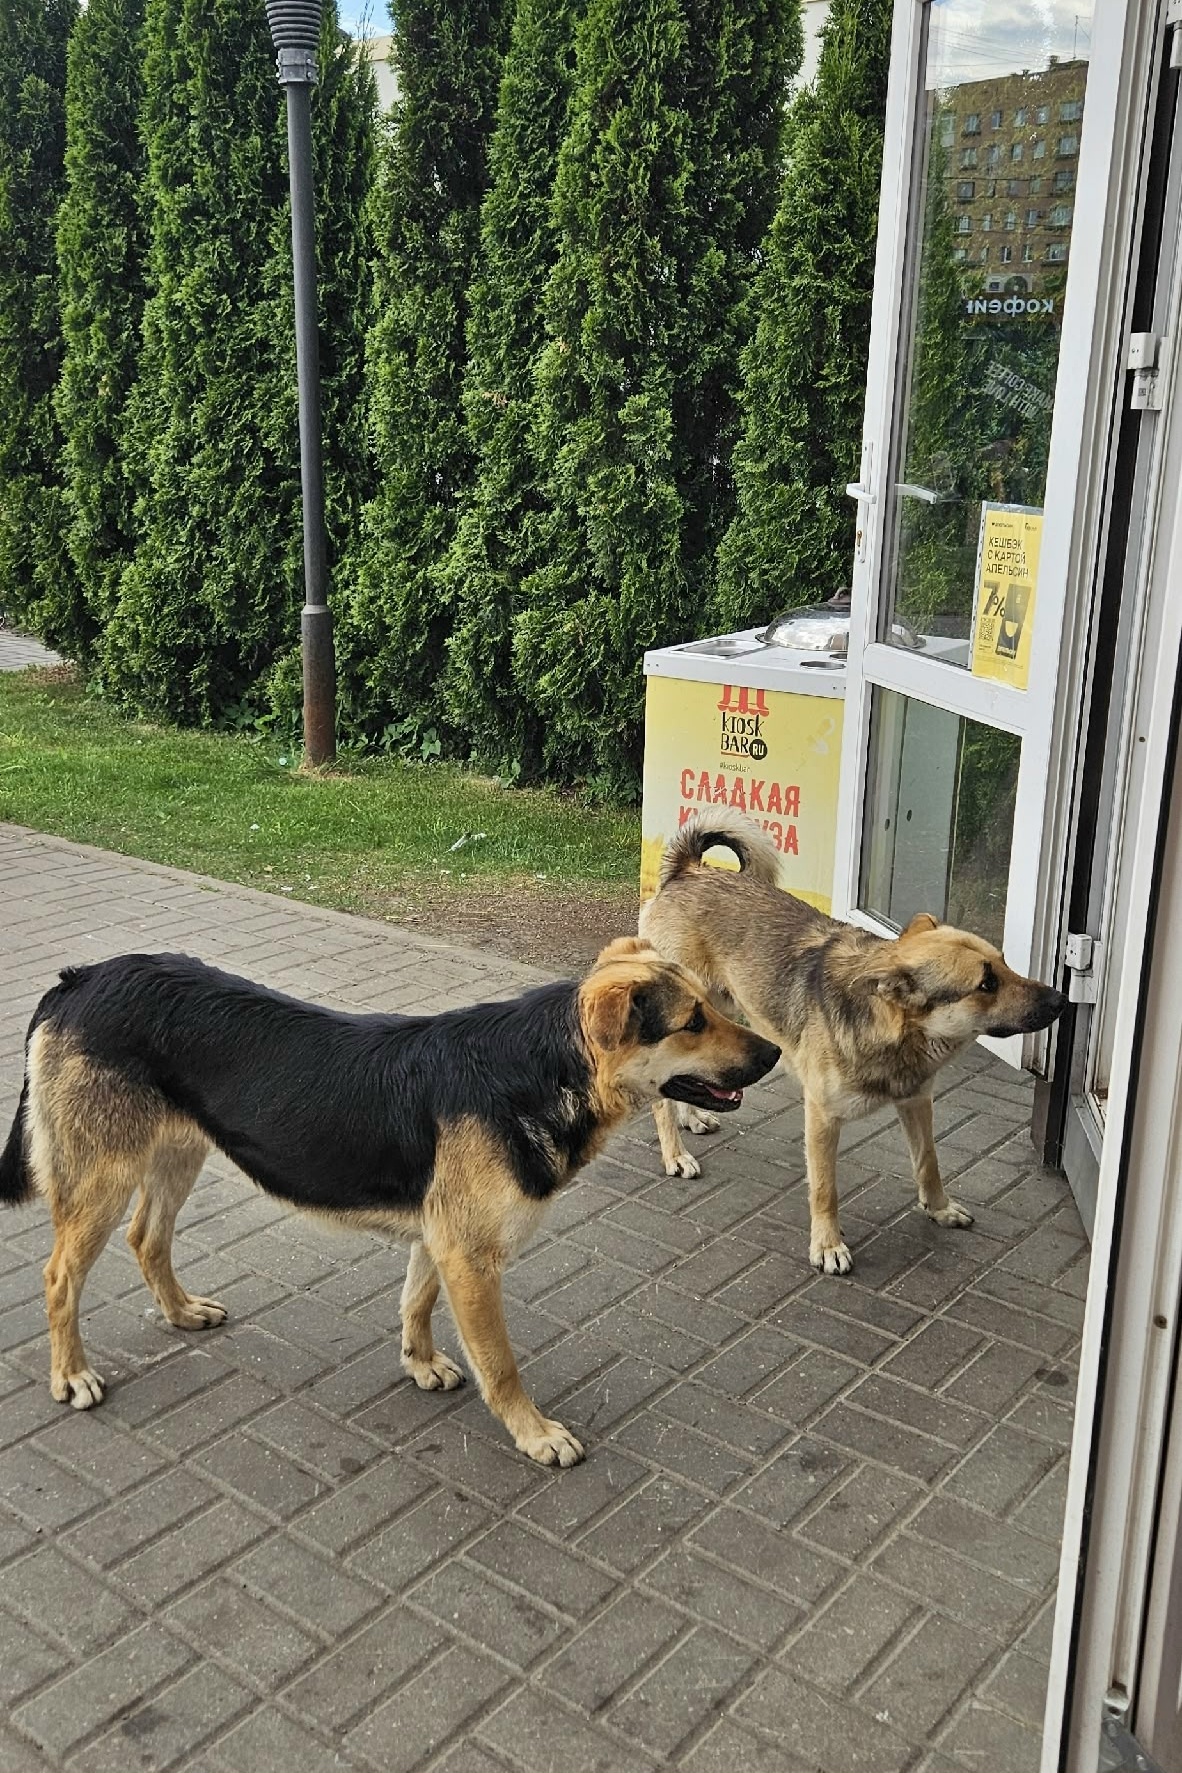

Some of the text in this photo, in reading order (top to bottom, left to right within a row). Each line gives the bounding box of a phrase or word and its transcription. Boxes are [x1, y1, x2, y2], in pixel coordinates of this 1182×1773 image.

[988, 536, 1023, 550] КЕШБЭК
[987, 549, 1026, 564] С КАРТОЙ
[985, 563, 1029, 579] АПЕЛЬСИН
[983, 580, 1006, 617] 7%
[720, 733, 750, 754] BAR
[680, 768, 801, 818] СЛАДКАЯ
